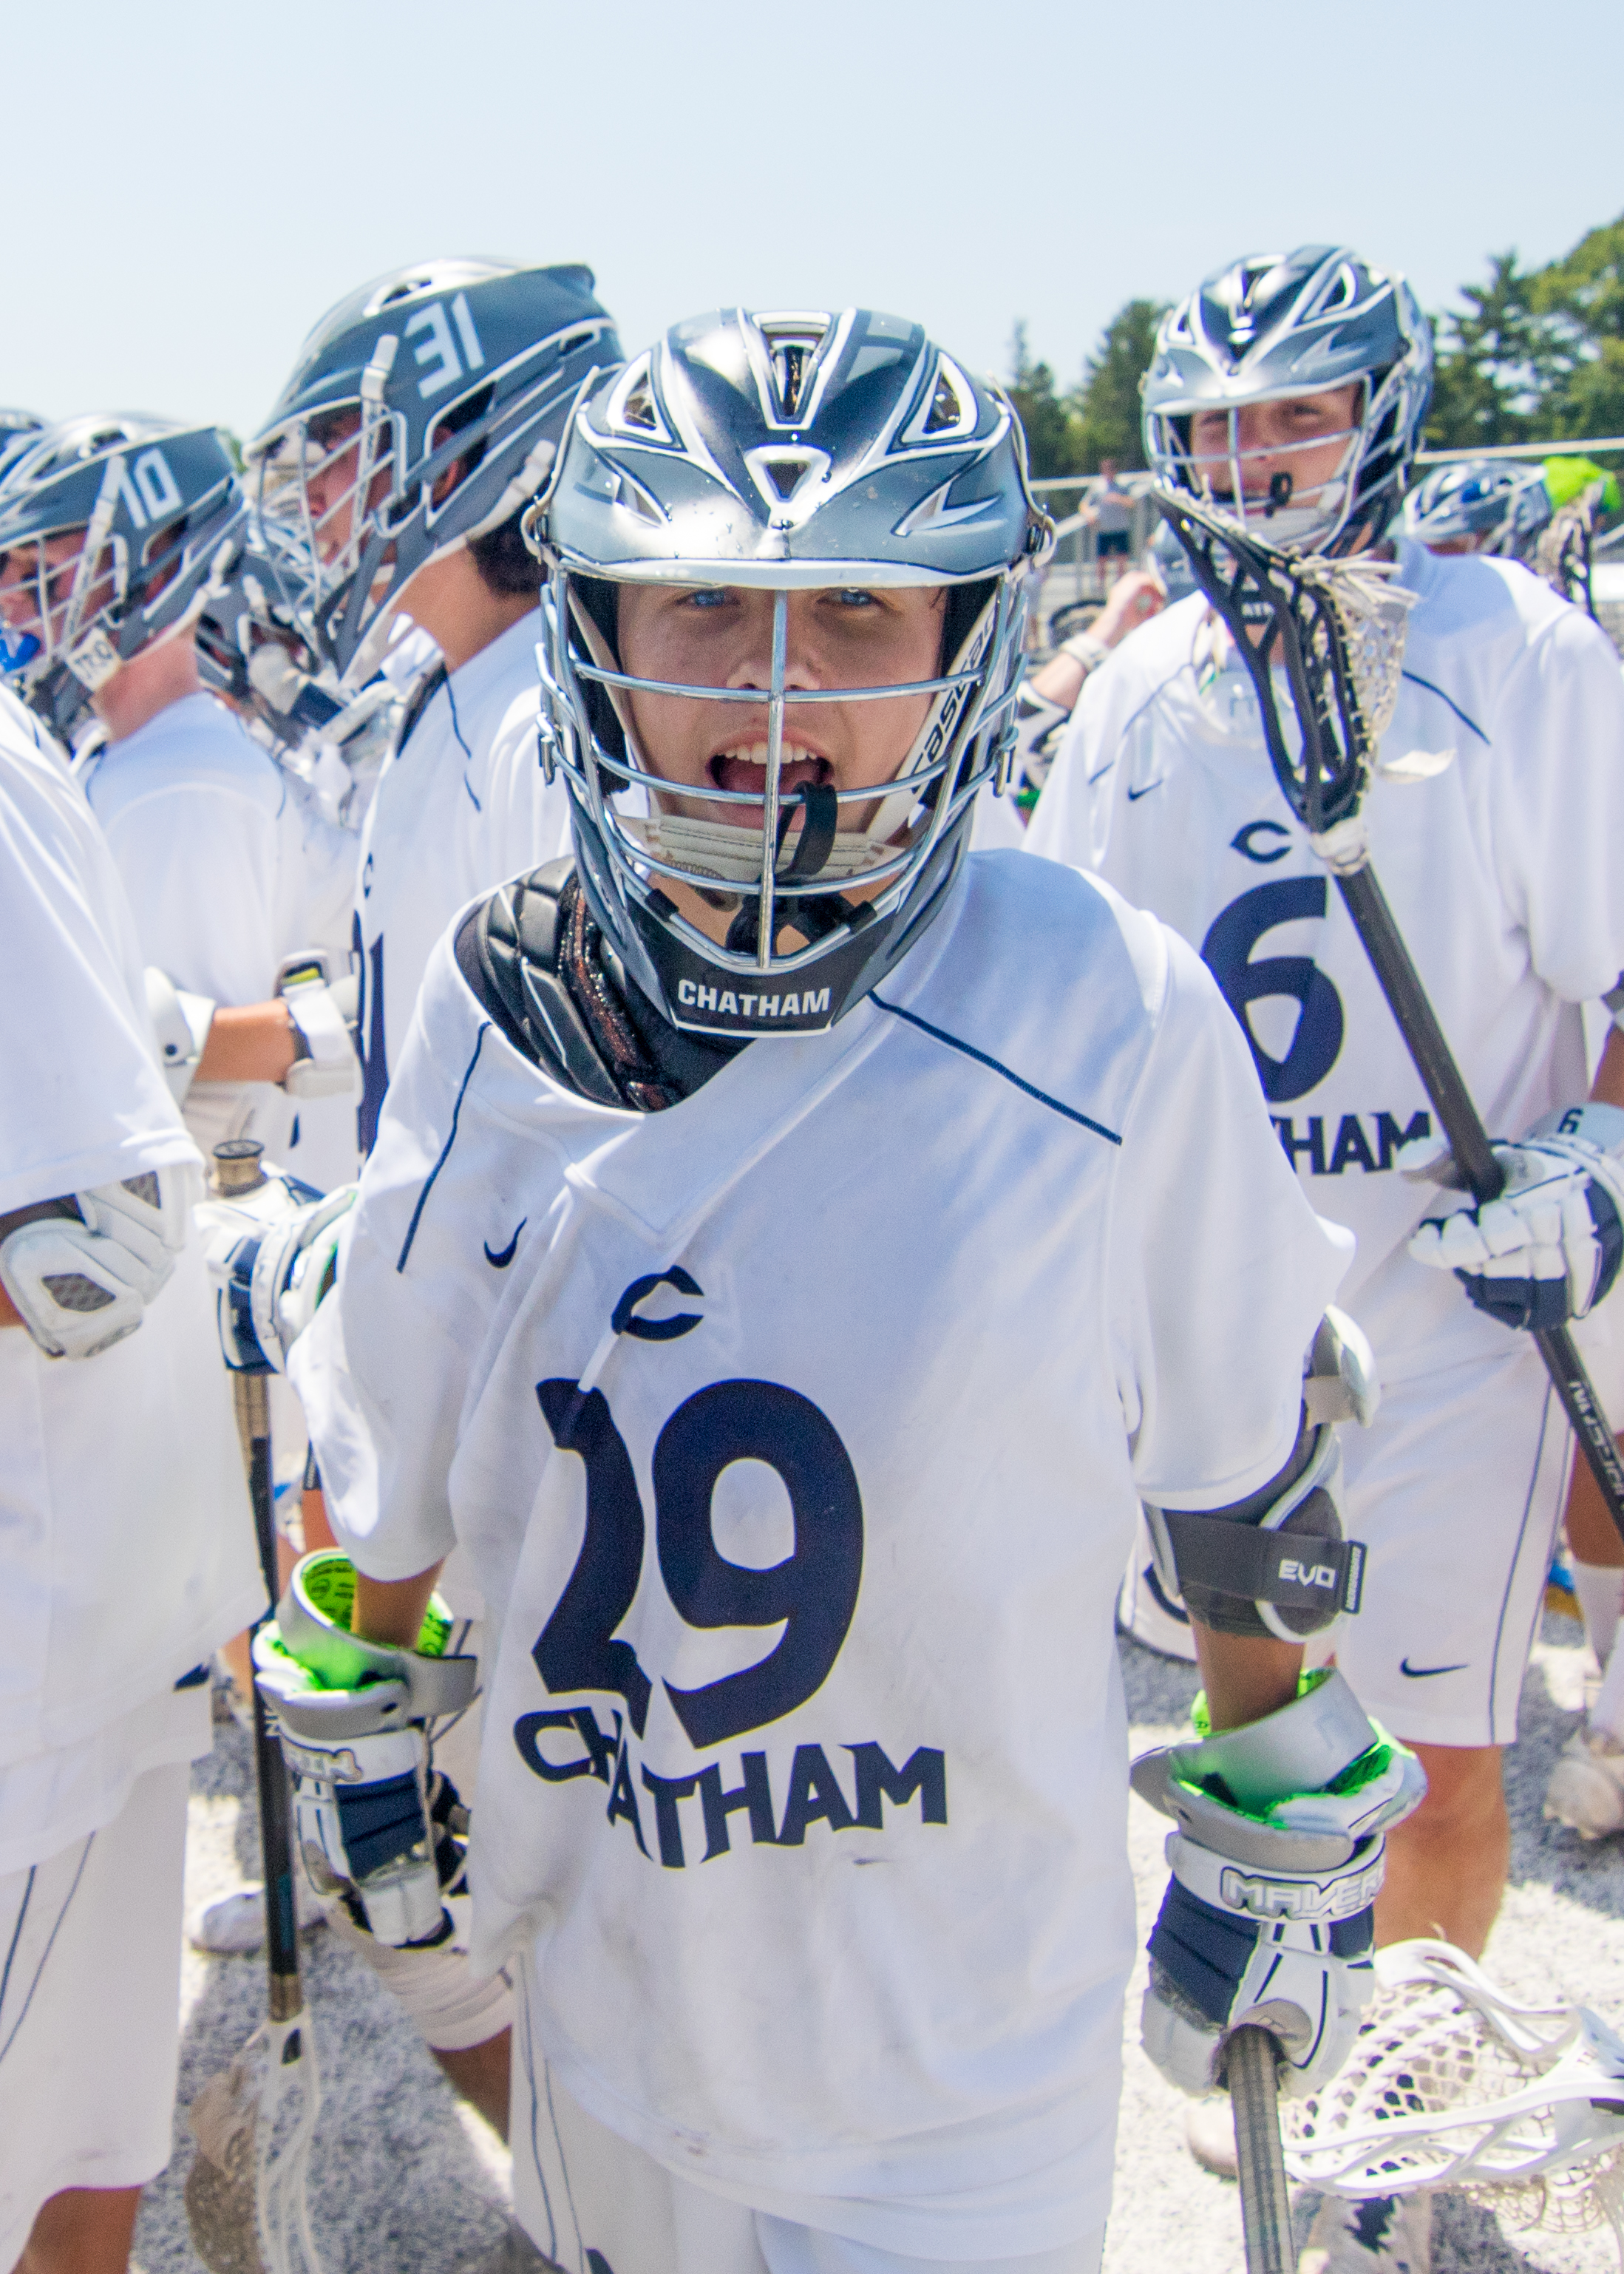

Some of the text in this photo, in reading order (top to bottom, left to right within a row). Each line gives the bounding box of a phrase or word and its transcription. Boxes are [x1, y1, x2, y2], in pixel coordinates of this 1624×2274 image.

[404, 292, 485, 400] 31
[118, 447, 183, 529] 10
[1230, 820, 1291, 865] C
[678, 978, 832, 1016] CHATHAM
[1200, 875, 1345, 1103] 6
[611, 1265, 704, 1342] C
[1278, 1559, 1336, 1589] EVO
[513, 1706, 948, 1869] CHATHAM
